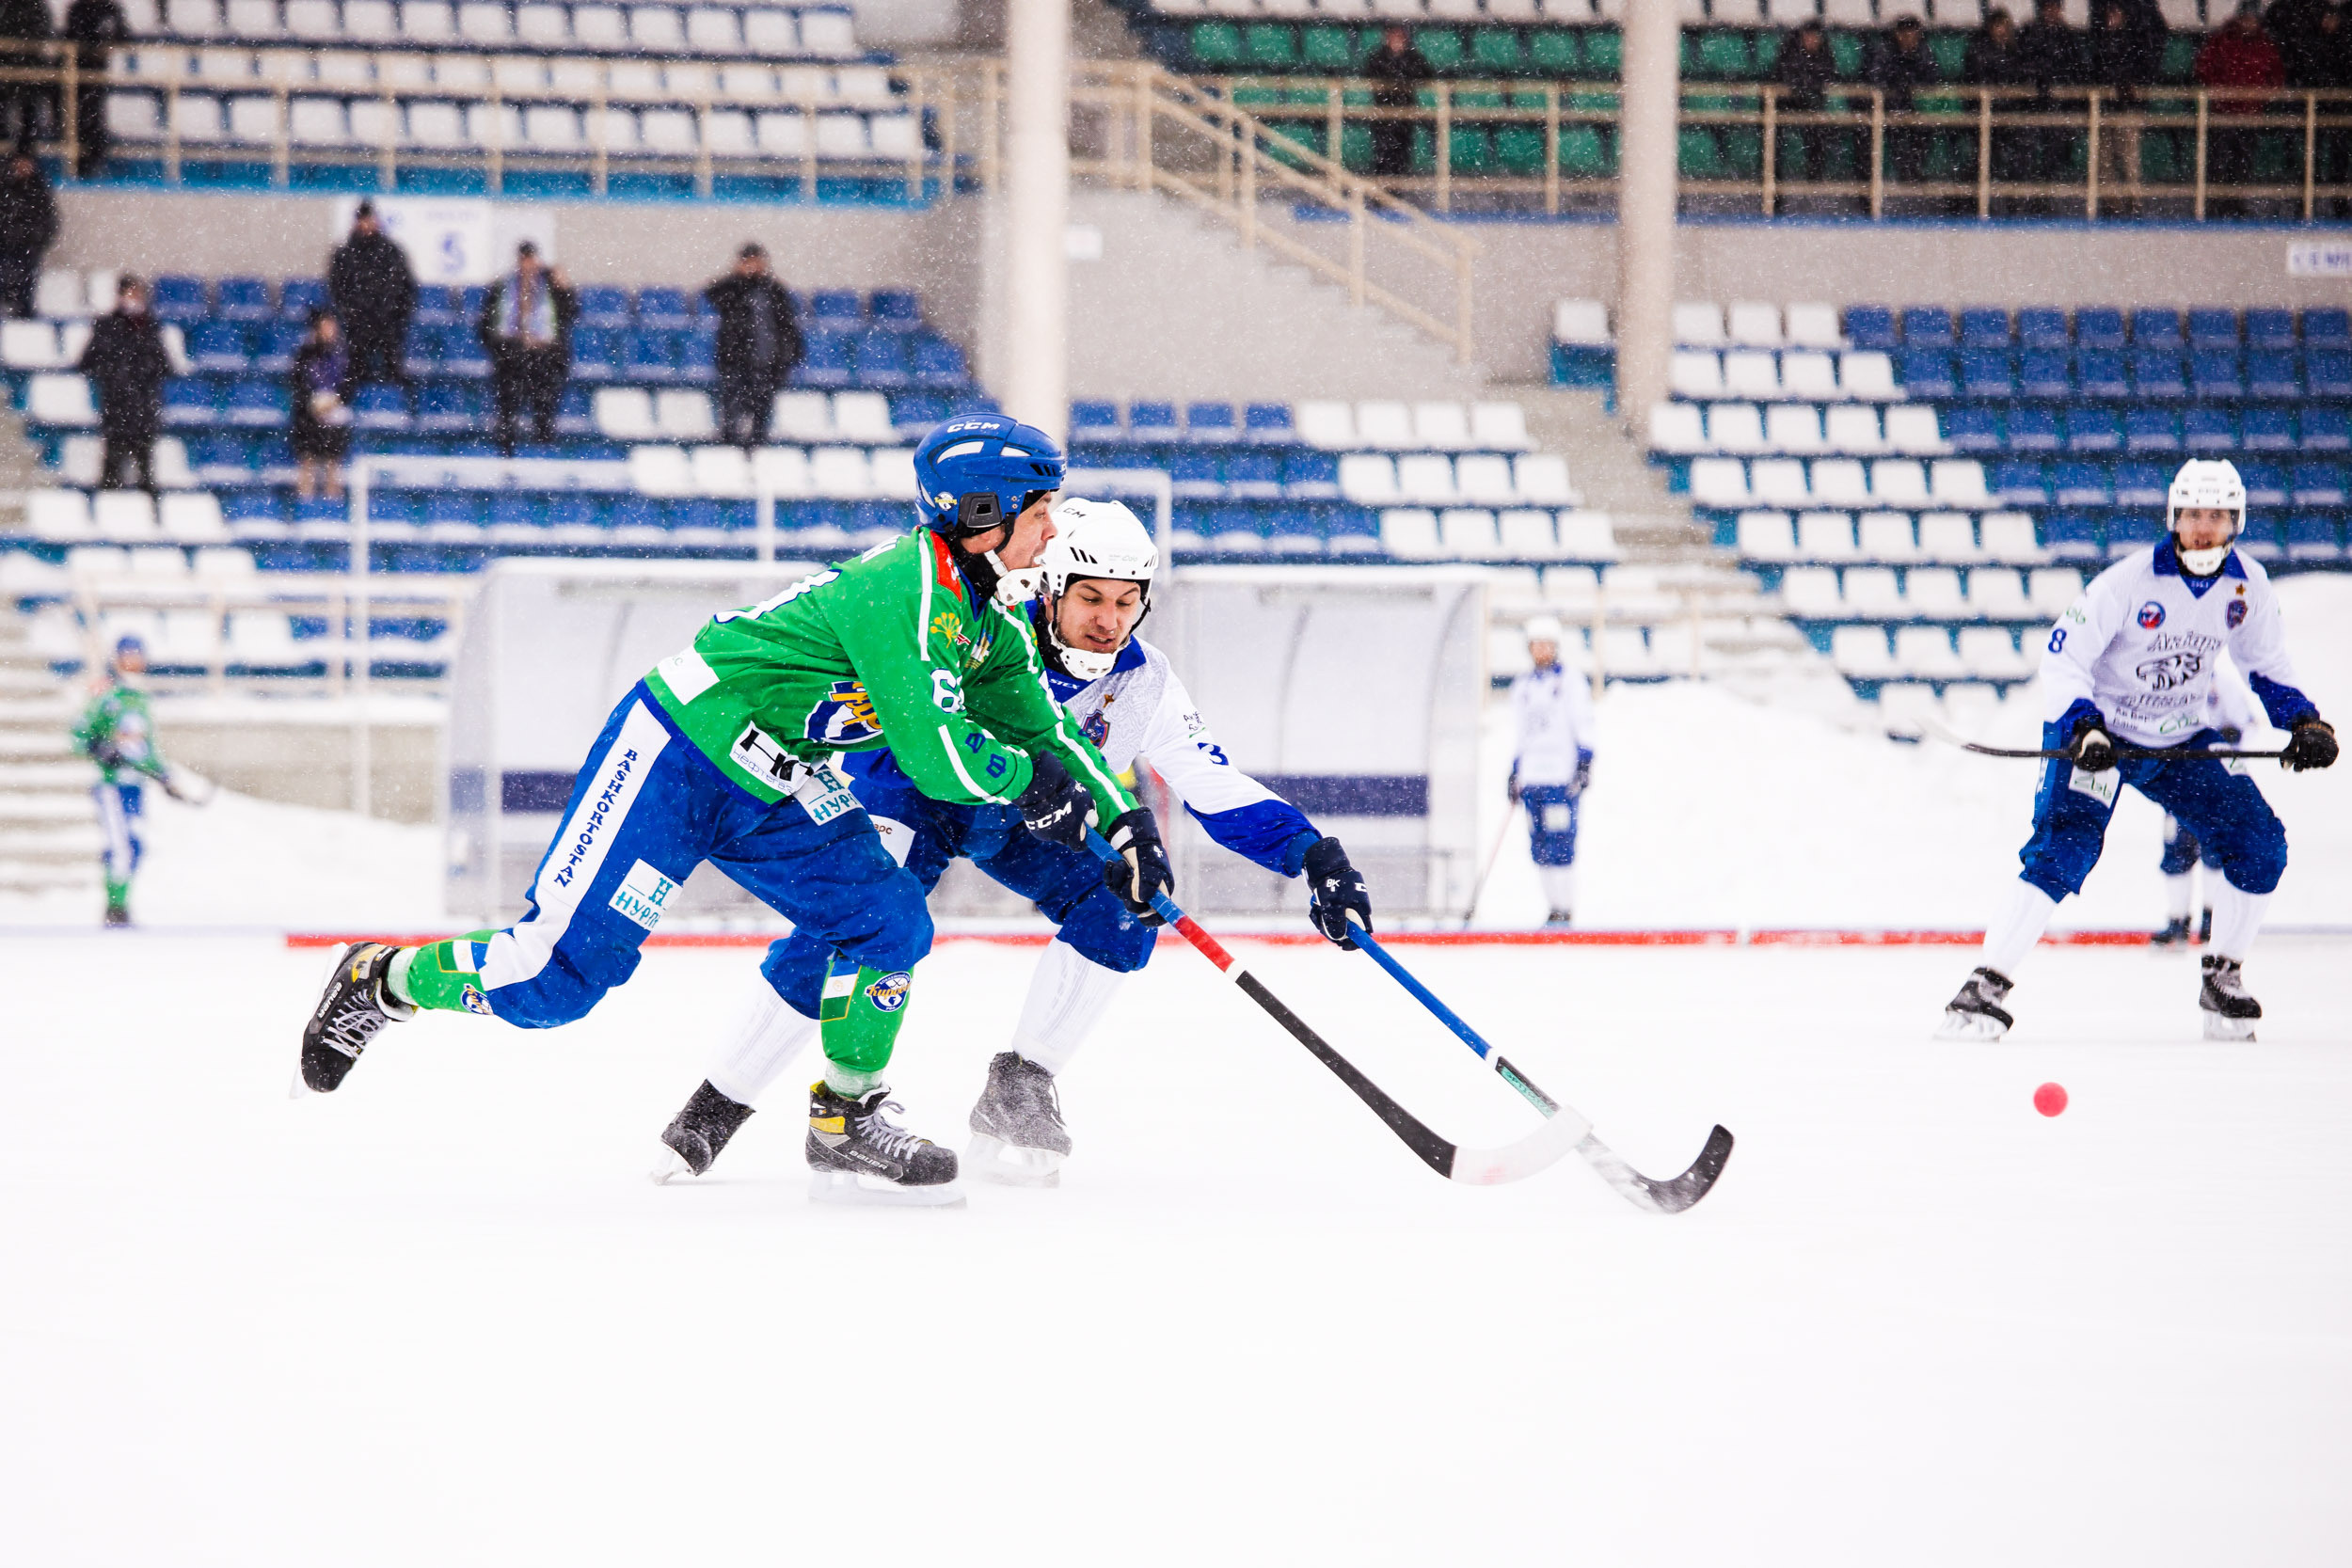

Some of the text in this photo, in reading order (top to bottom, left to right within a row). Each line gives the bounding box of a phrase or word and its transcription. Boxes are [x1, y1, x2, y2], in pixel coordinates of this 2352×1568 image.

[947, 422, 1000, 434] CCM
[2048, 628, 2067, 653] 8
[1197, 742, 1229, 766] 3
[553, 749, 638, 887] BASHKORTOSTAN
[1025, 800, 1072, 830] CCM
[317, 981, 342, 1019] BAUER
[850, 1149, 888, 1171] BAUER
